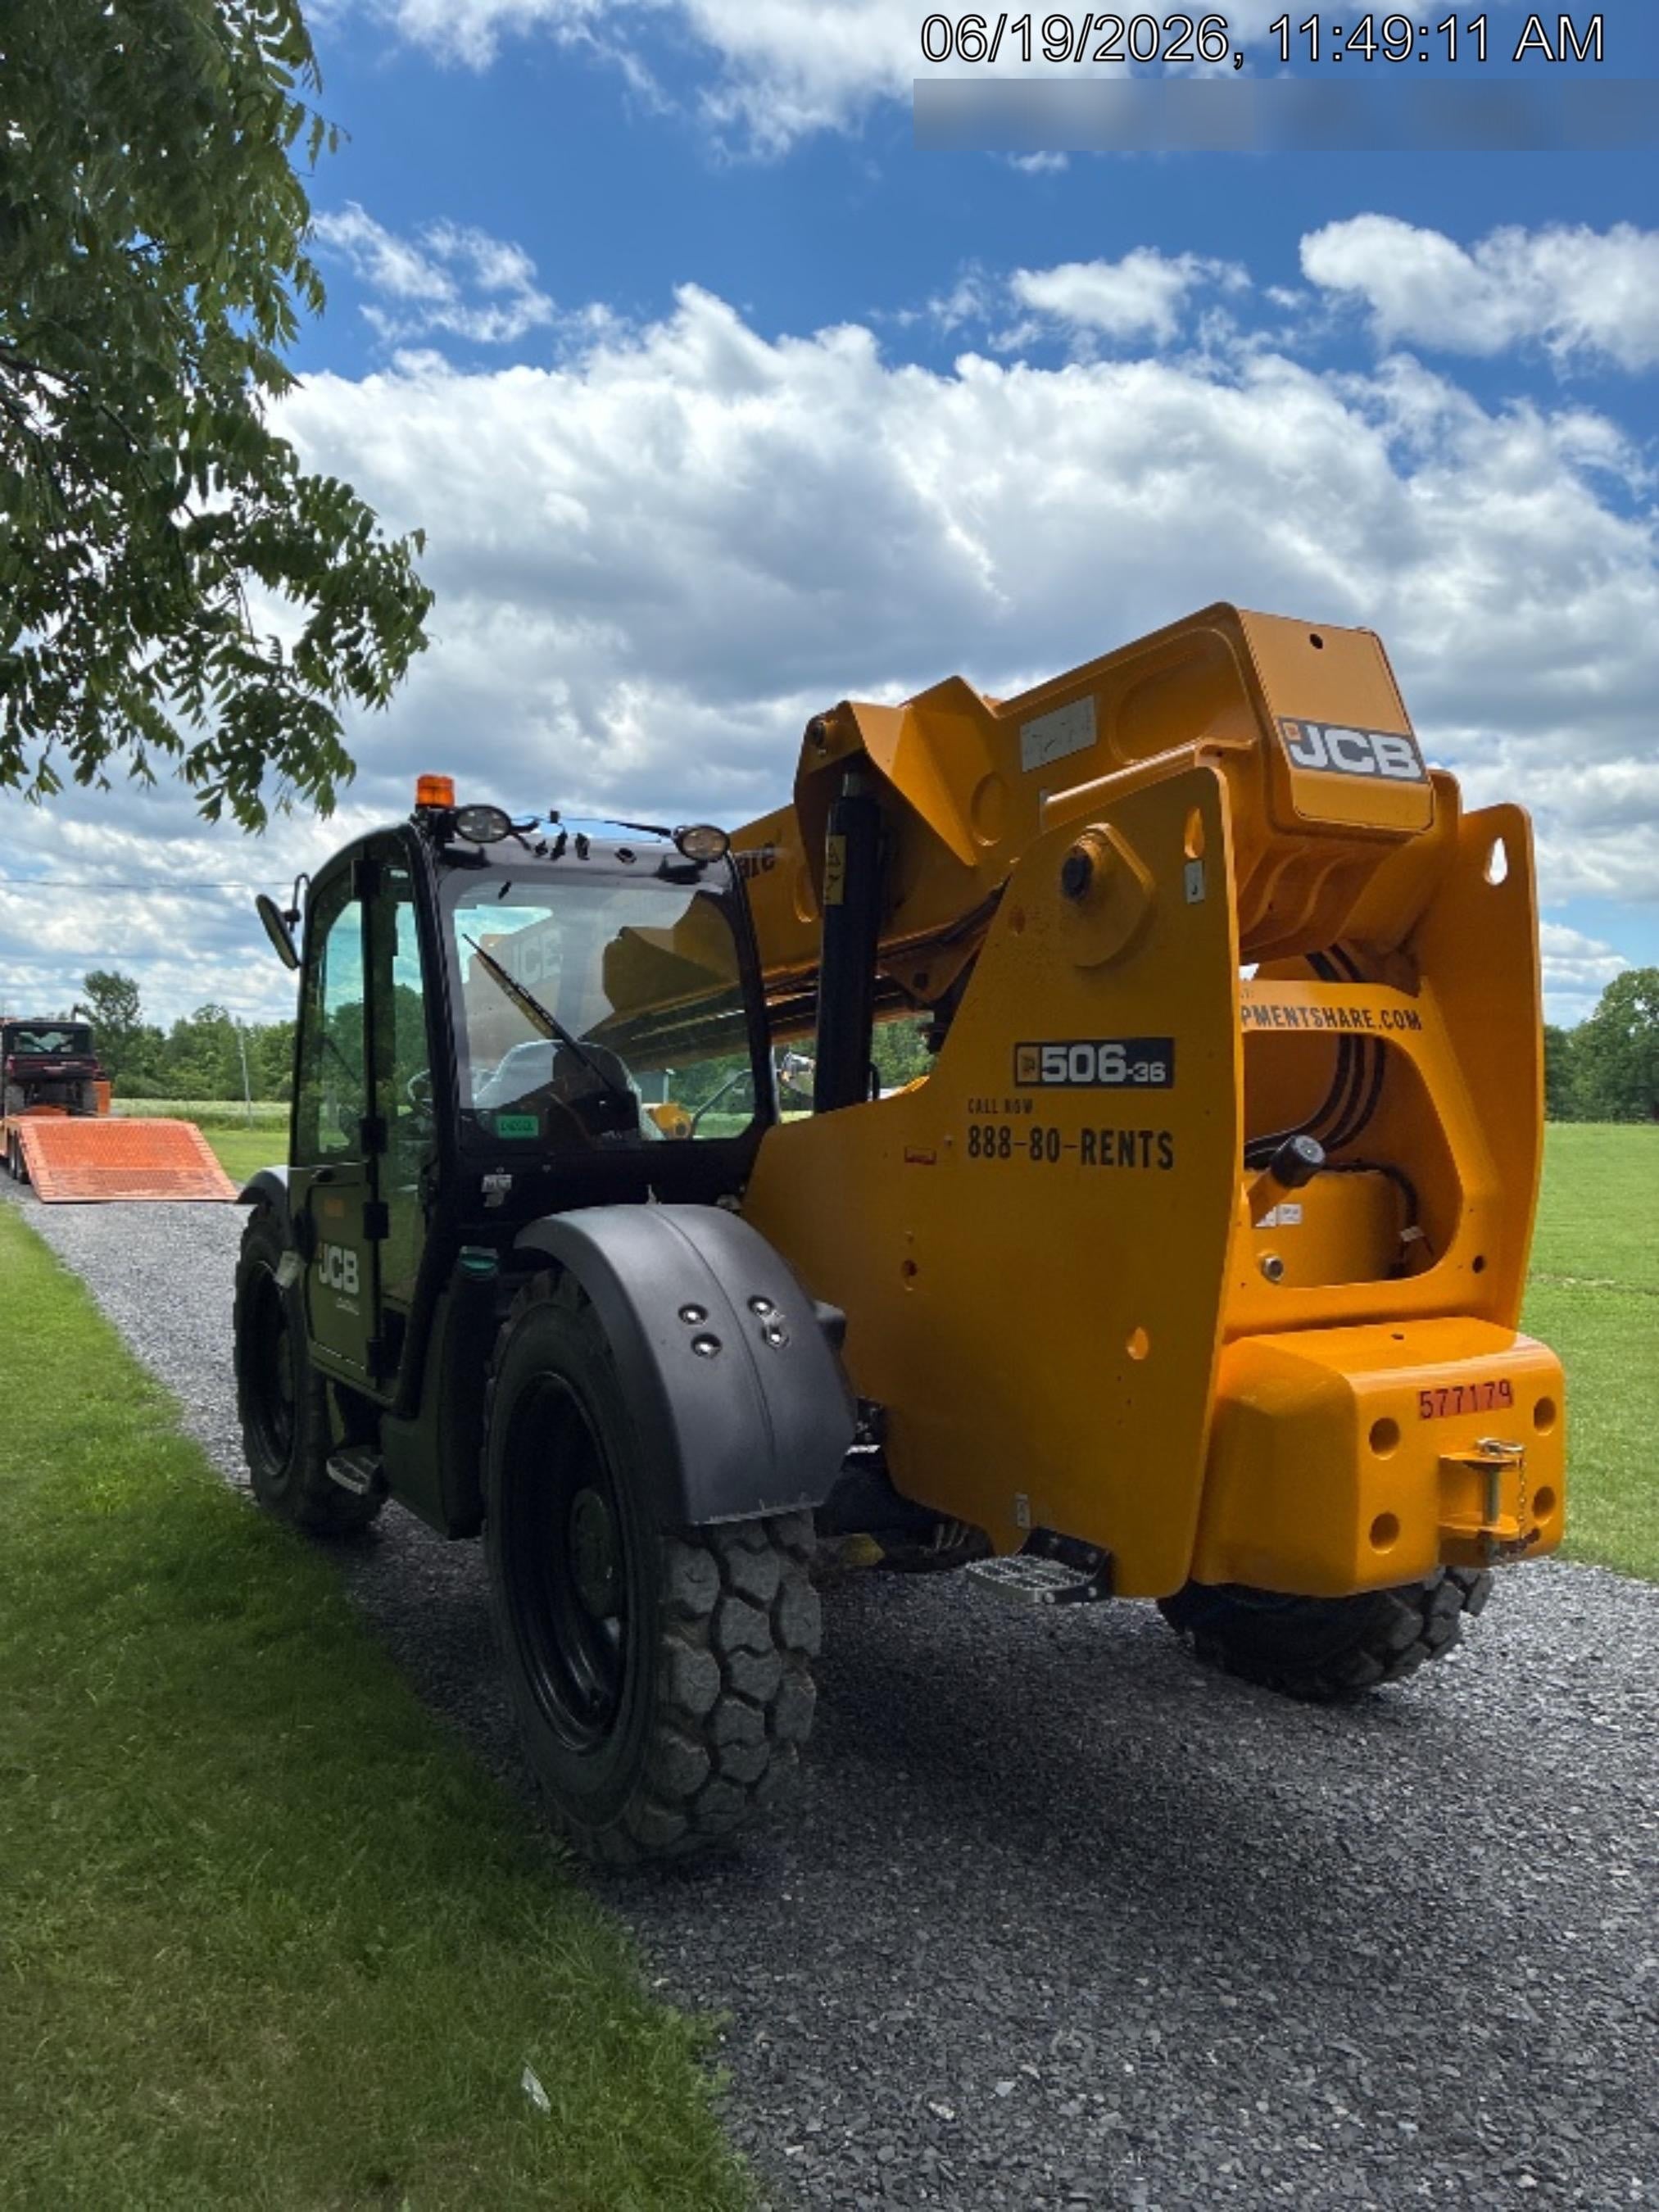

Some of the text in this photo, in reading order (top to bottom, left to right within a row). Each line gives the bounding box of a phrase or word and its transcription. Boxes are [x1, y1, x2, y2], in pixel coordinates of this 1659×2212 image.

[1290, 725, 1422, 778] JCB
[1041, 1043, 1167, 1082] 506-36
[968, 1098, 1034, 1114] CALL NOW
[968, 1125, 1174, 1171] 888-80-RENTS
[318, 1242, 360, 1295] JCB
[1419, 1378, 1513, 1419] 577179
